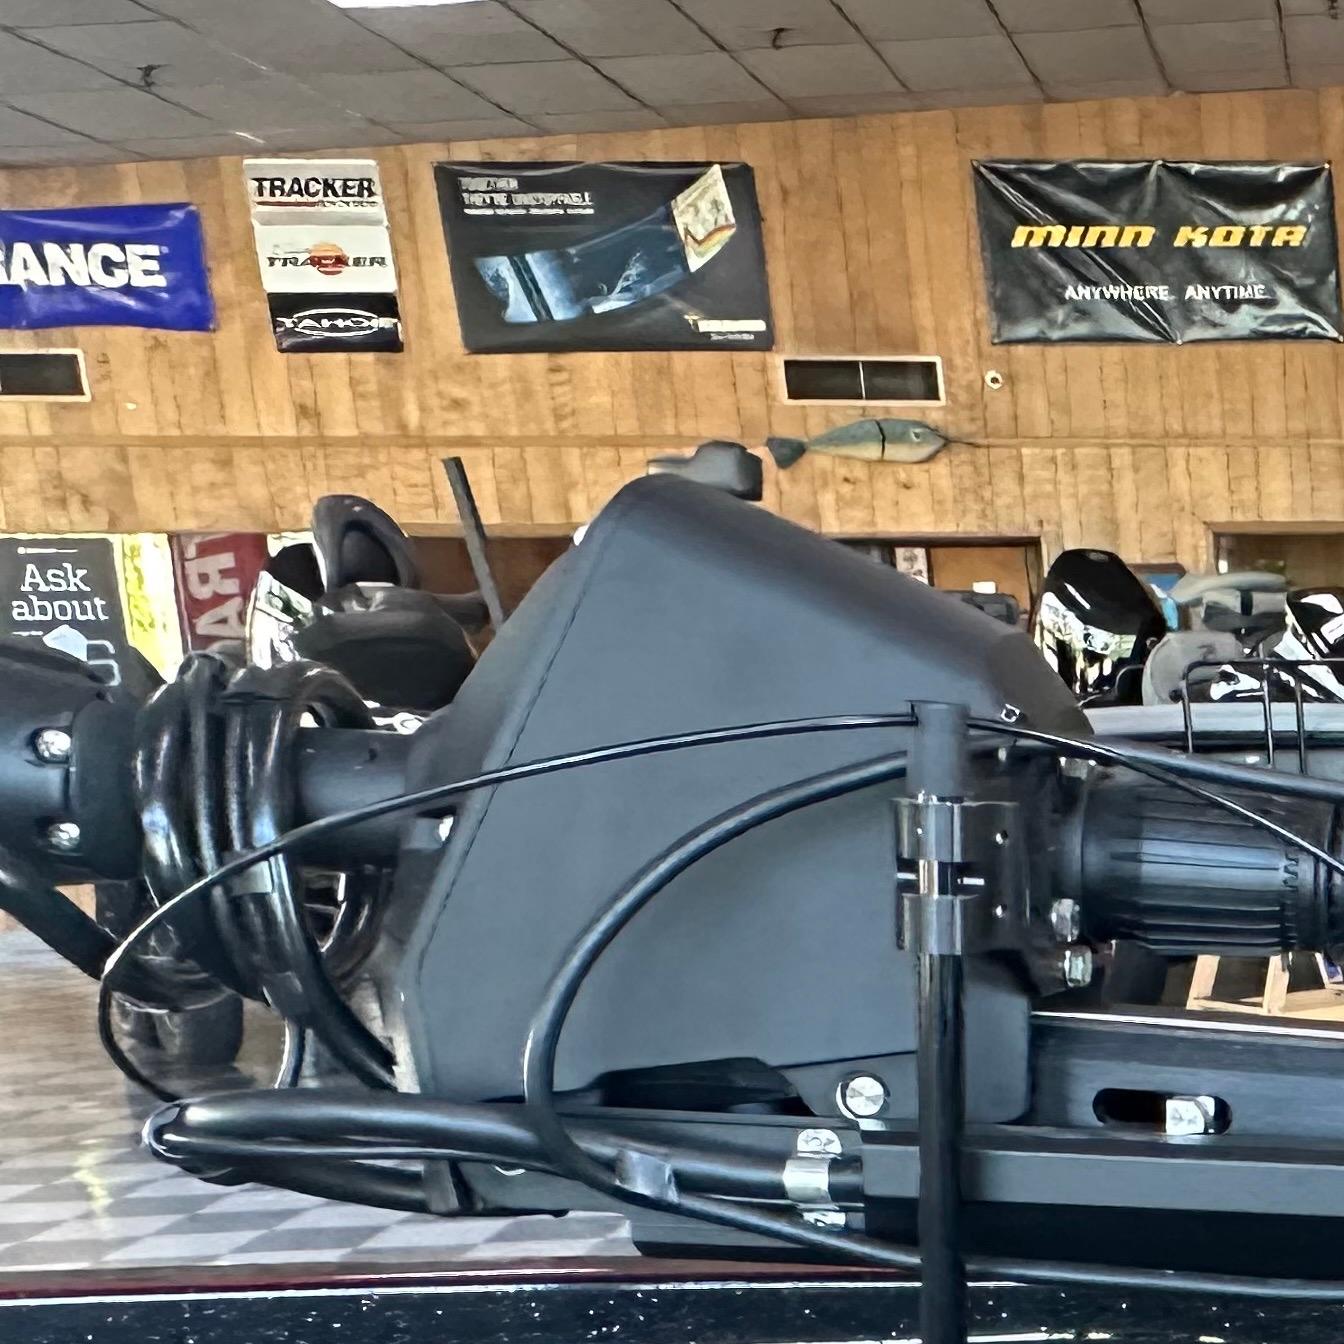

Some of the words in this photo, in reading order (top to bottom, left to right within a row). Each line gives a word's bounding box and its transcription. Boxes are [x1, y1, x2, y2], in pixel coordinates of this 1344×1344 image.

[251, 177, 378, 198] TRACKER
[1173, 225, 1307, 247] KOTA
[20, 563, 91, 592] Ask
[11, 595, 109, 621] about
